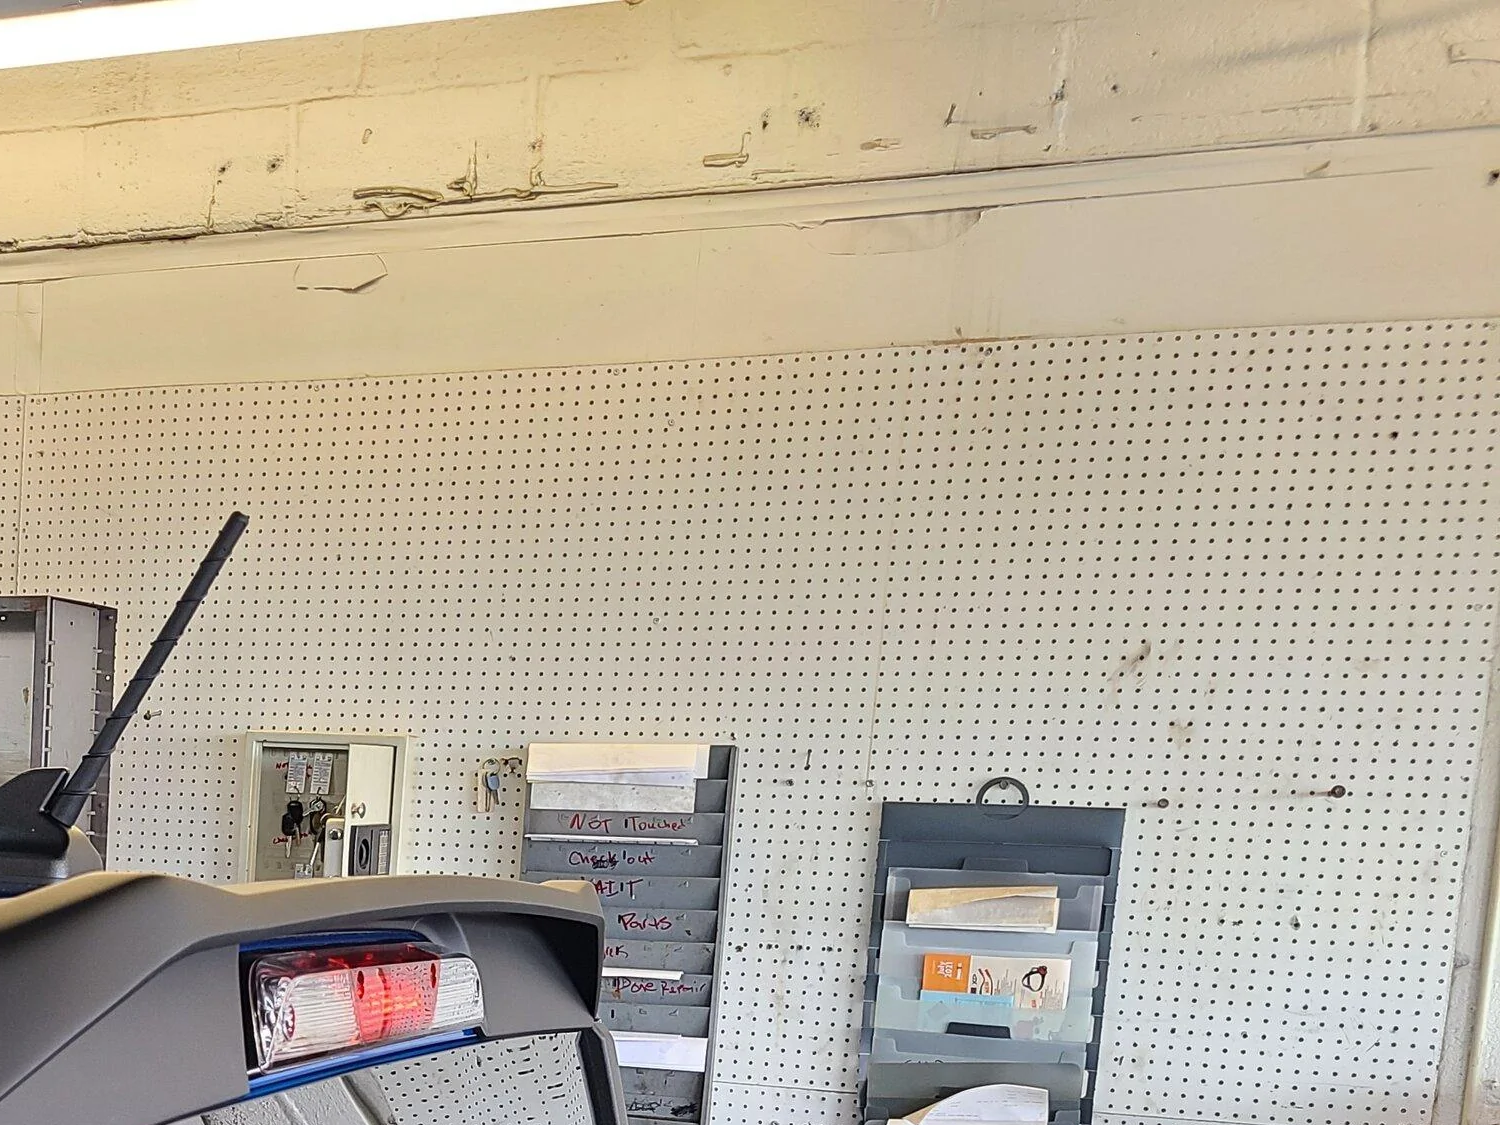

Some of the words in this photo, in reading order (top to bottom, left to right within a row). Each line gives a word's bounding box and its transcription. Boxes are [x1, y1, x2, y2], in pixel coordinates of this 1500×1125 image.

[569, 813, 612, 833] NOT
[587, 877, 643, 898] AIT
[619, 912, 672, 930] Parts
